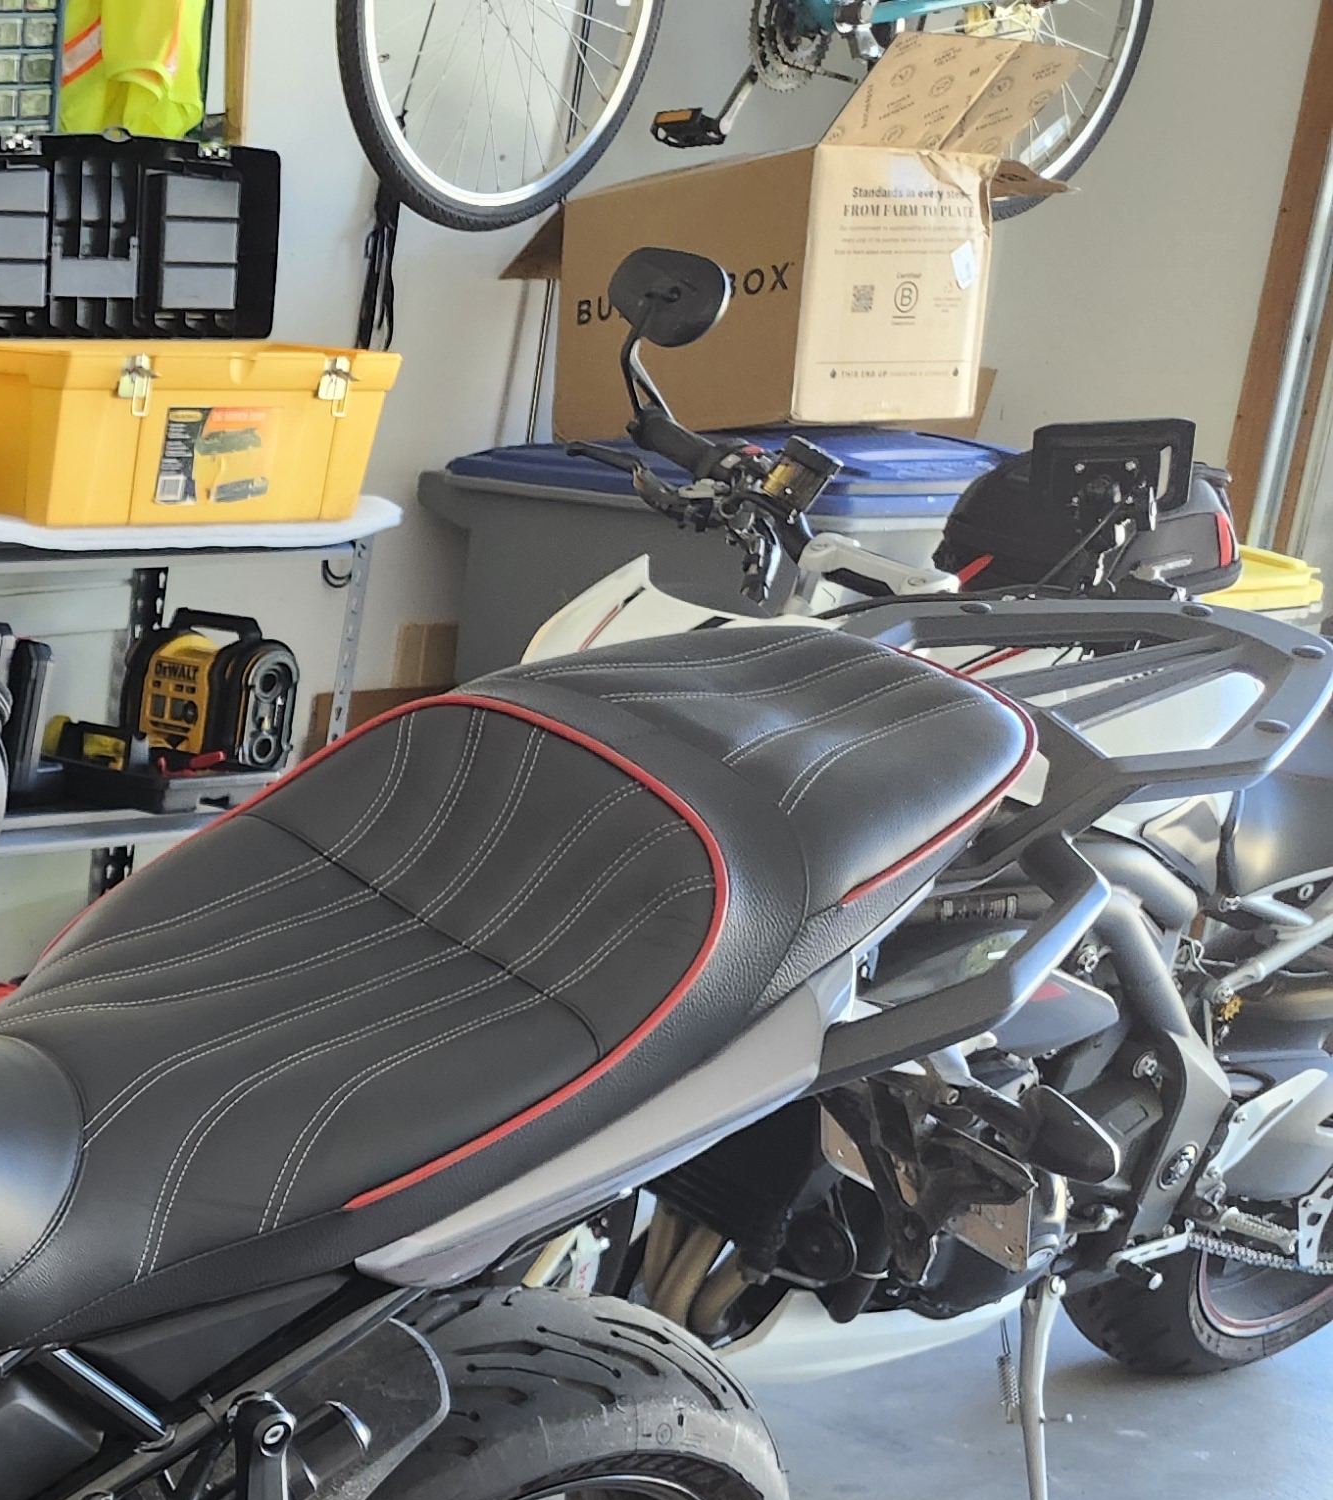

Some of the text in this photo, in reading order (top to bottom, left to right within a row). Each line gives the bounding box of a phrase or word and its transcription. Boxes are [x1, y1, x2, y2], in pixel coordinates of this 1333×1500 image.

[918, 190, 944, 202] every
[843, 204, 880, 217] FROM
[883, 204, 919, 217] FARM
[922, 205, 937, 217] TO
